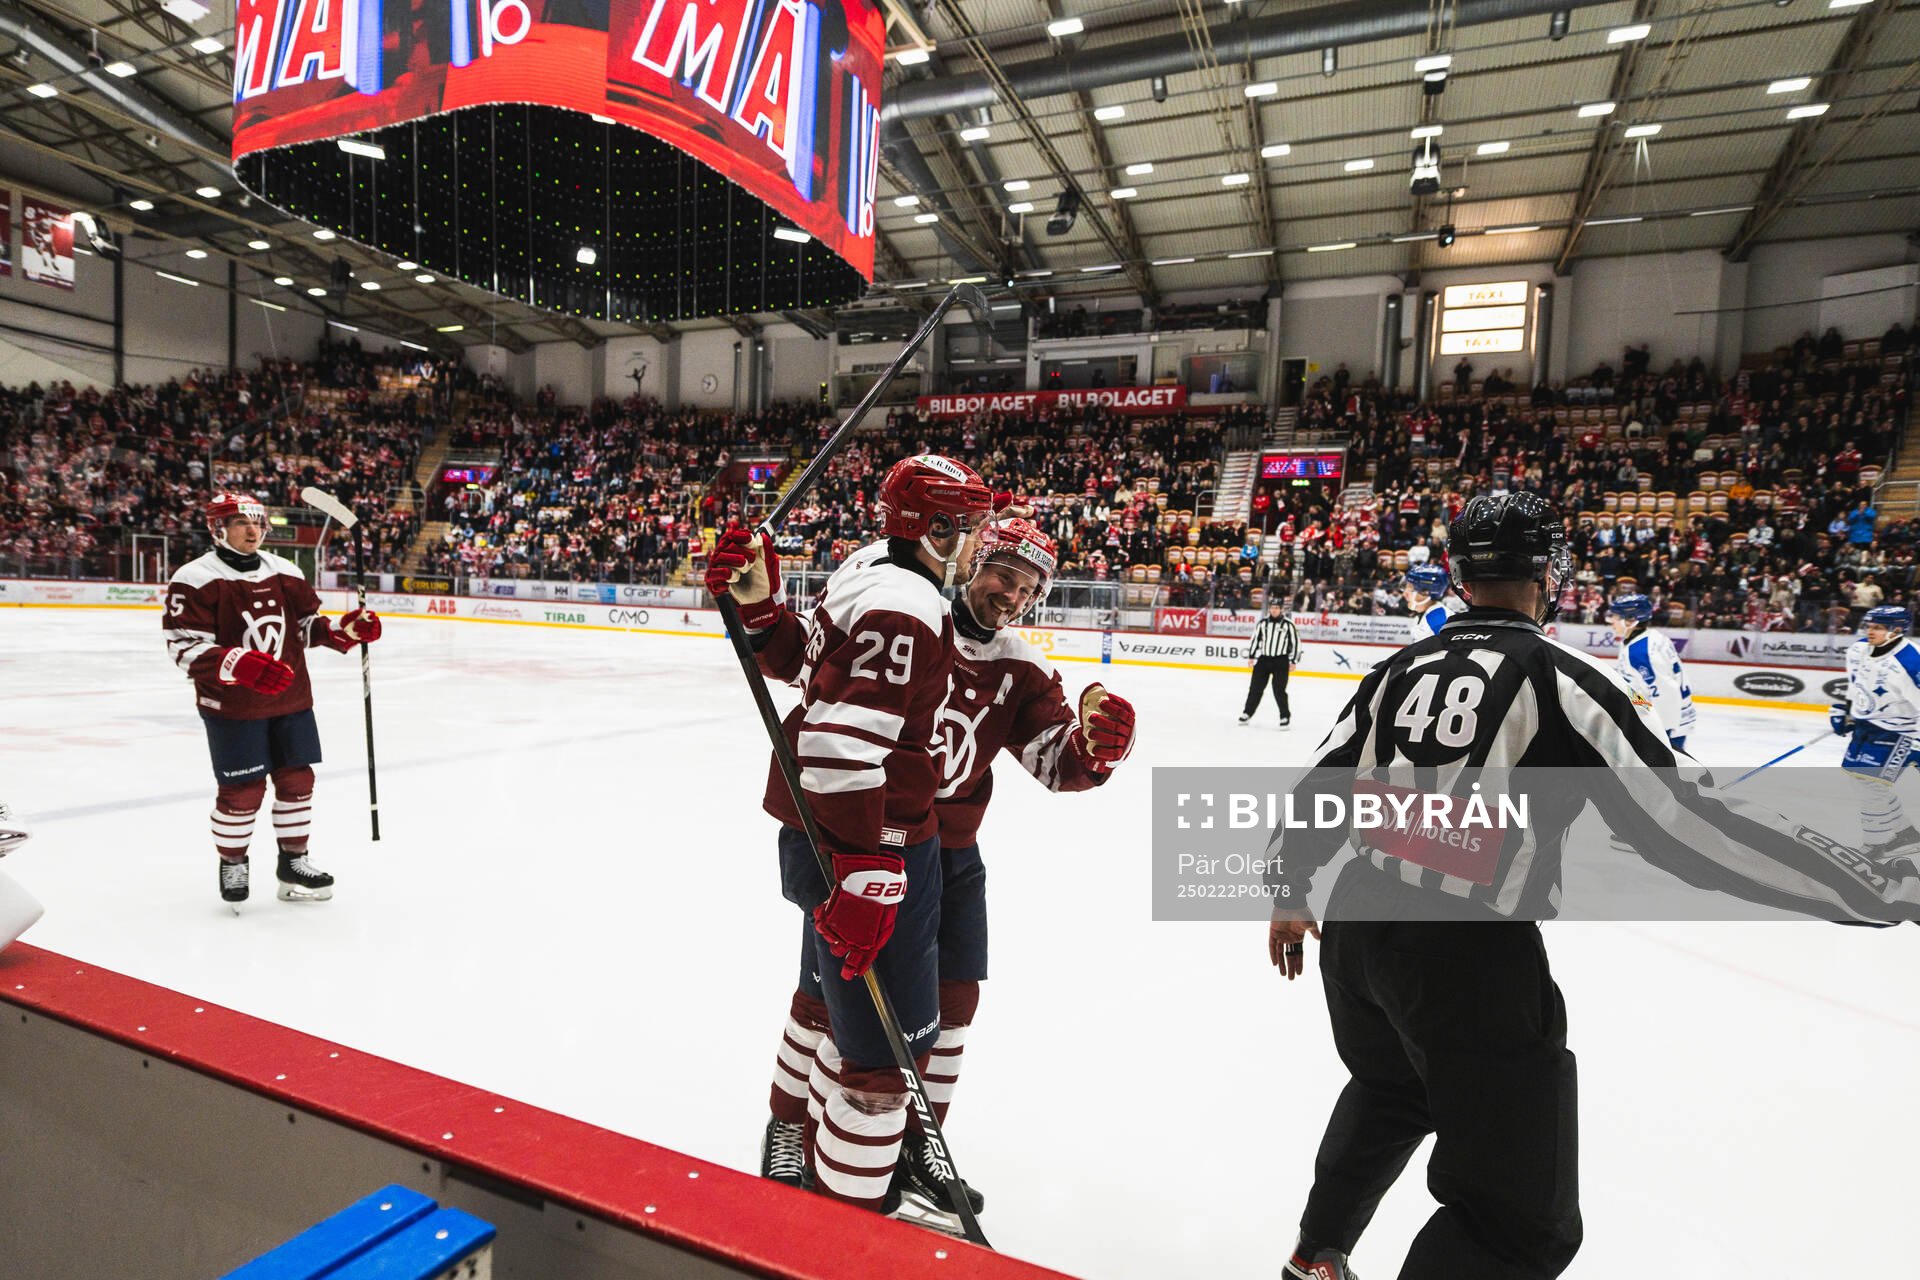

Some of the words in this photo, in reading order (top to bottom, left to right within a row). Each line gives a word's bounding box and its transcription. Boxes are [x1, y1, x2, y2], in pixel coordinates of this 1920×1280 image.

[1469, 291, 1504, 300] TAXI
[1465, 339, 1500, 347] TAXI
[930, 395, 1036, 414] BILBOLAGET
[1058, 389, 1177, 408] BILBOLAGET
[427, 599, 456, 614] ABB
[544, 612, 585, 623] TIRAB
[609, 609, 649, 624] CAMO
[1161, 614, 1201, 629] AVIS
[1212, 614, 1255, 623] BUCHER
[850, 630, 914, 685] 29
[963, 644, 976, 656] SHL
[993, 673, 1013, 705] A
[1394, 674, 1485, 747] 48
[1801, 832, 1886, 887] CCM
